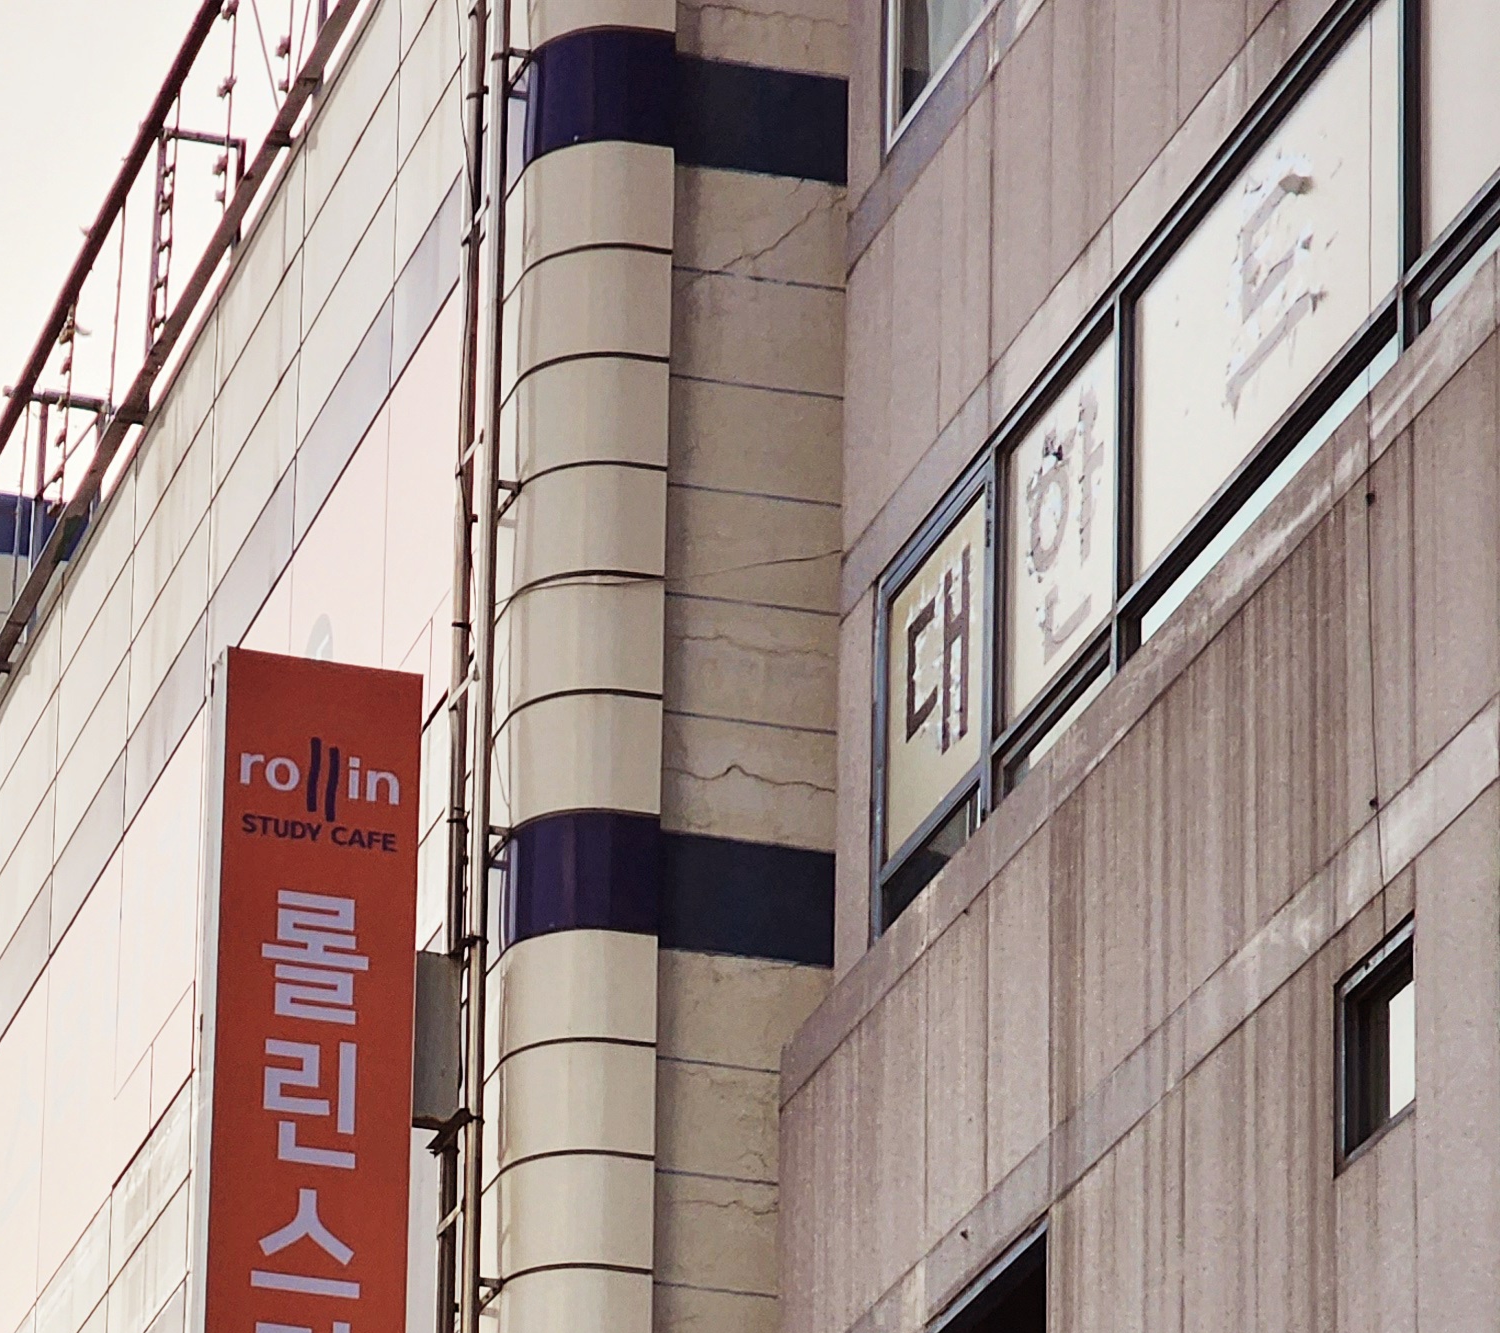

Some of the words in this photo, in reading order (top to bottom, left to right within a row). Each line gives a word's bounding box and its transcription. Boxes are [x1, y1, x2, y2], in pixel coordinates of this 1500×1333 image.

[238, 736, 400, 822] rollin
[241, 813, 322, 843] STUDY
[330, 825, 398, 853] CAFE
